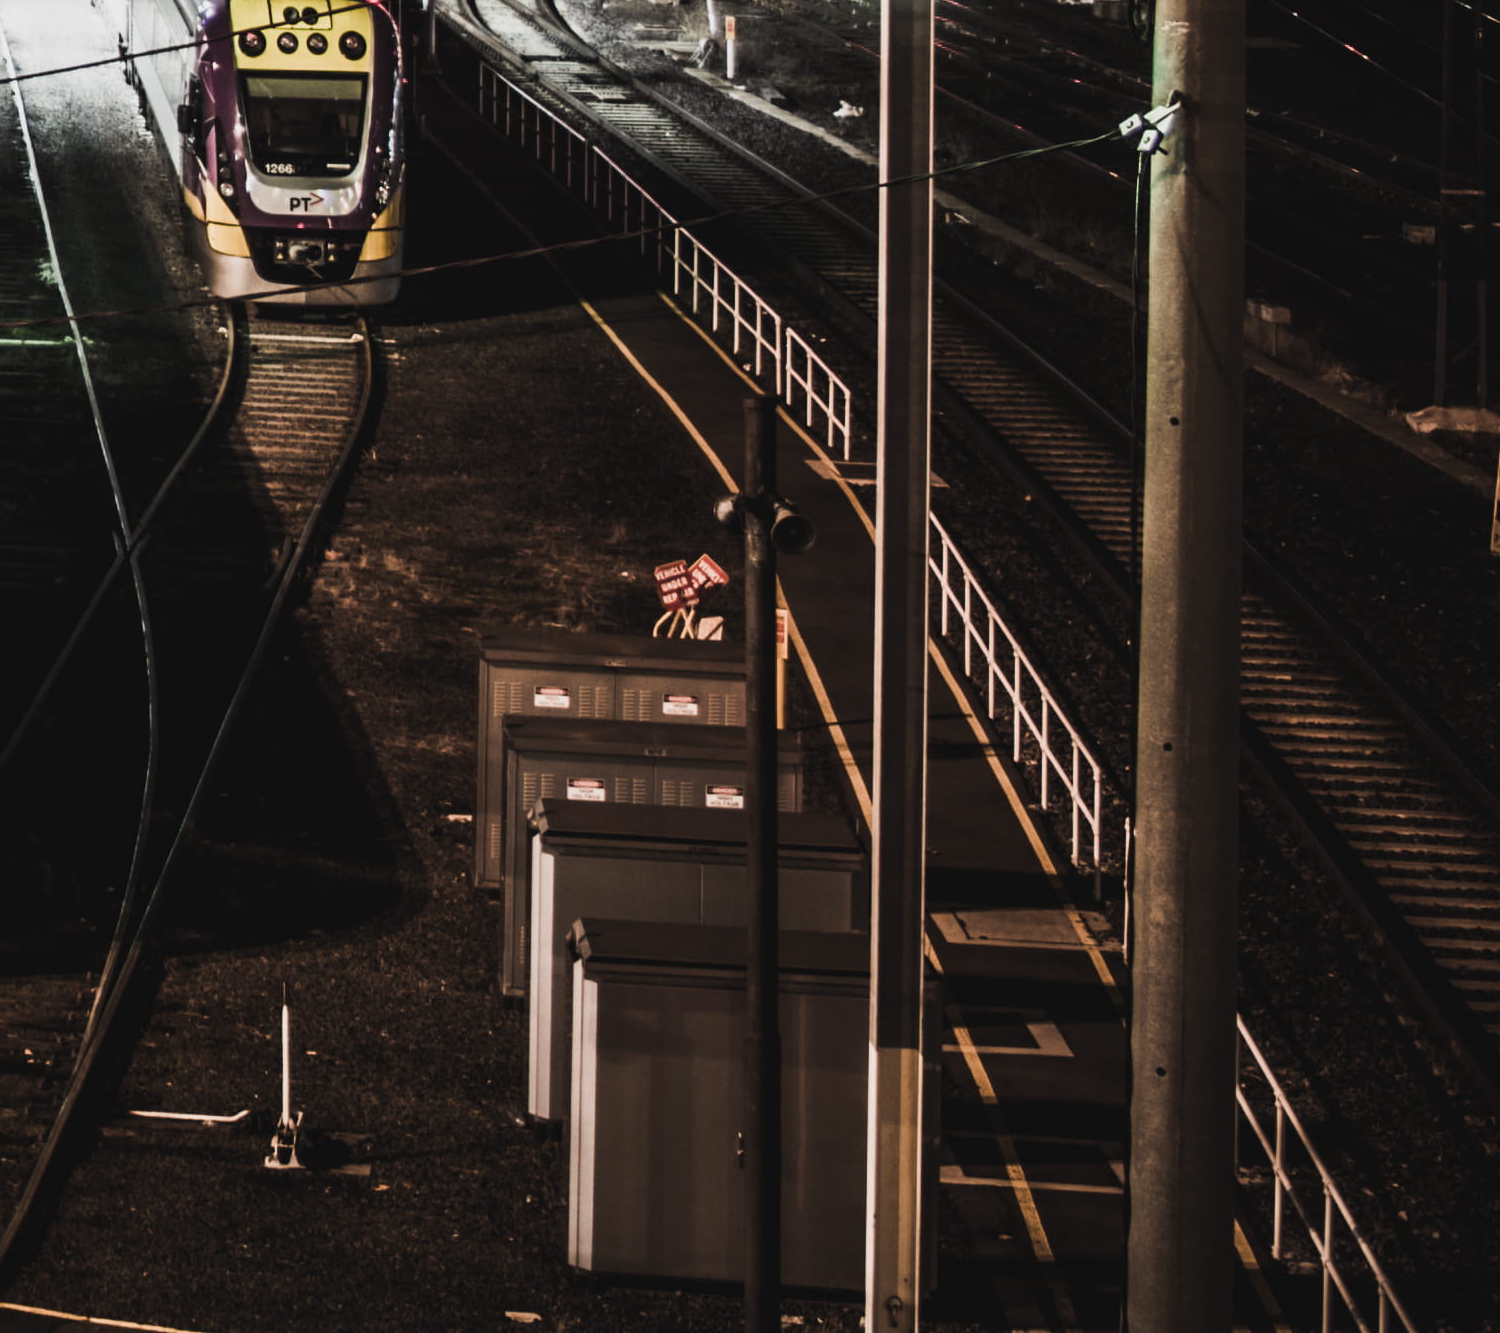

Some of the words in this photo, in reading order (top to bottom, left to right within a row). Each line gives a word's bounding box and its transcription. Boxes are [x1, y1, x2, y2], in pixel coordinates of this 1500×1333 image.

[265, 163, 293, 174] 1266
[289, 197, 311, 212] PT
[655, 565, 686, 581] VEHICLE
[660, 577, 688, 592] UNDER
[662, 587, 695, 605] REPIR
